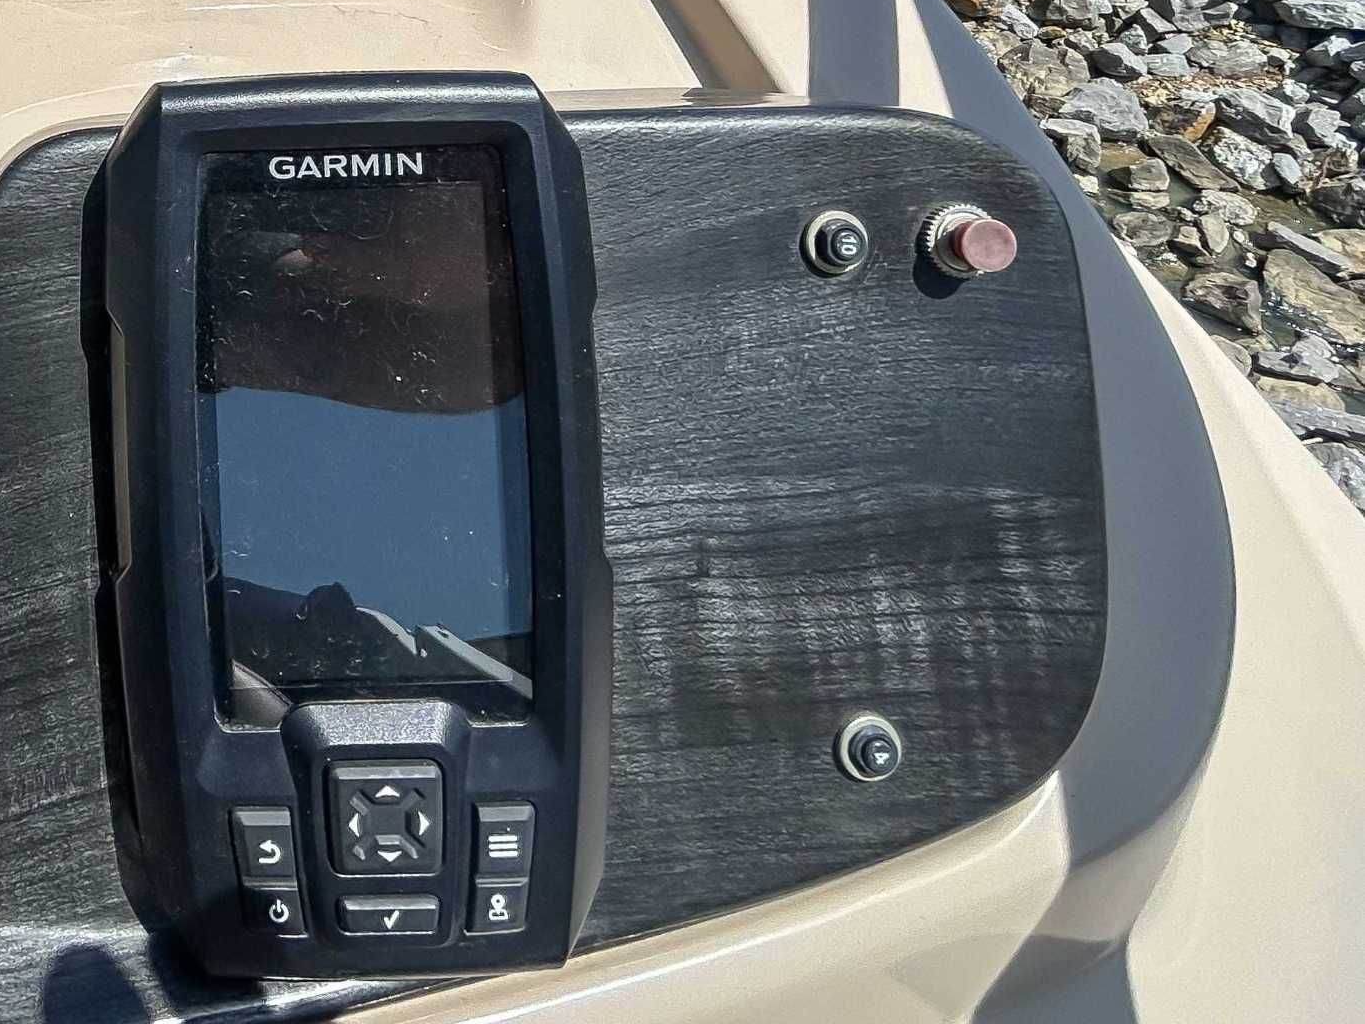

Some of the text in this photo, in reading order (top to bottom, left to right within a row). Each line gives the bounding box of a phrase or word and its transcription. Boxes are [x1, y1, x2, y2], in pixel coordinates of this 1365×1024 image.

[268, 151, 424, 180] GARMIN
[841, 236, 857, 255] 10
[874, 752, 890, 765] 4
